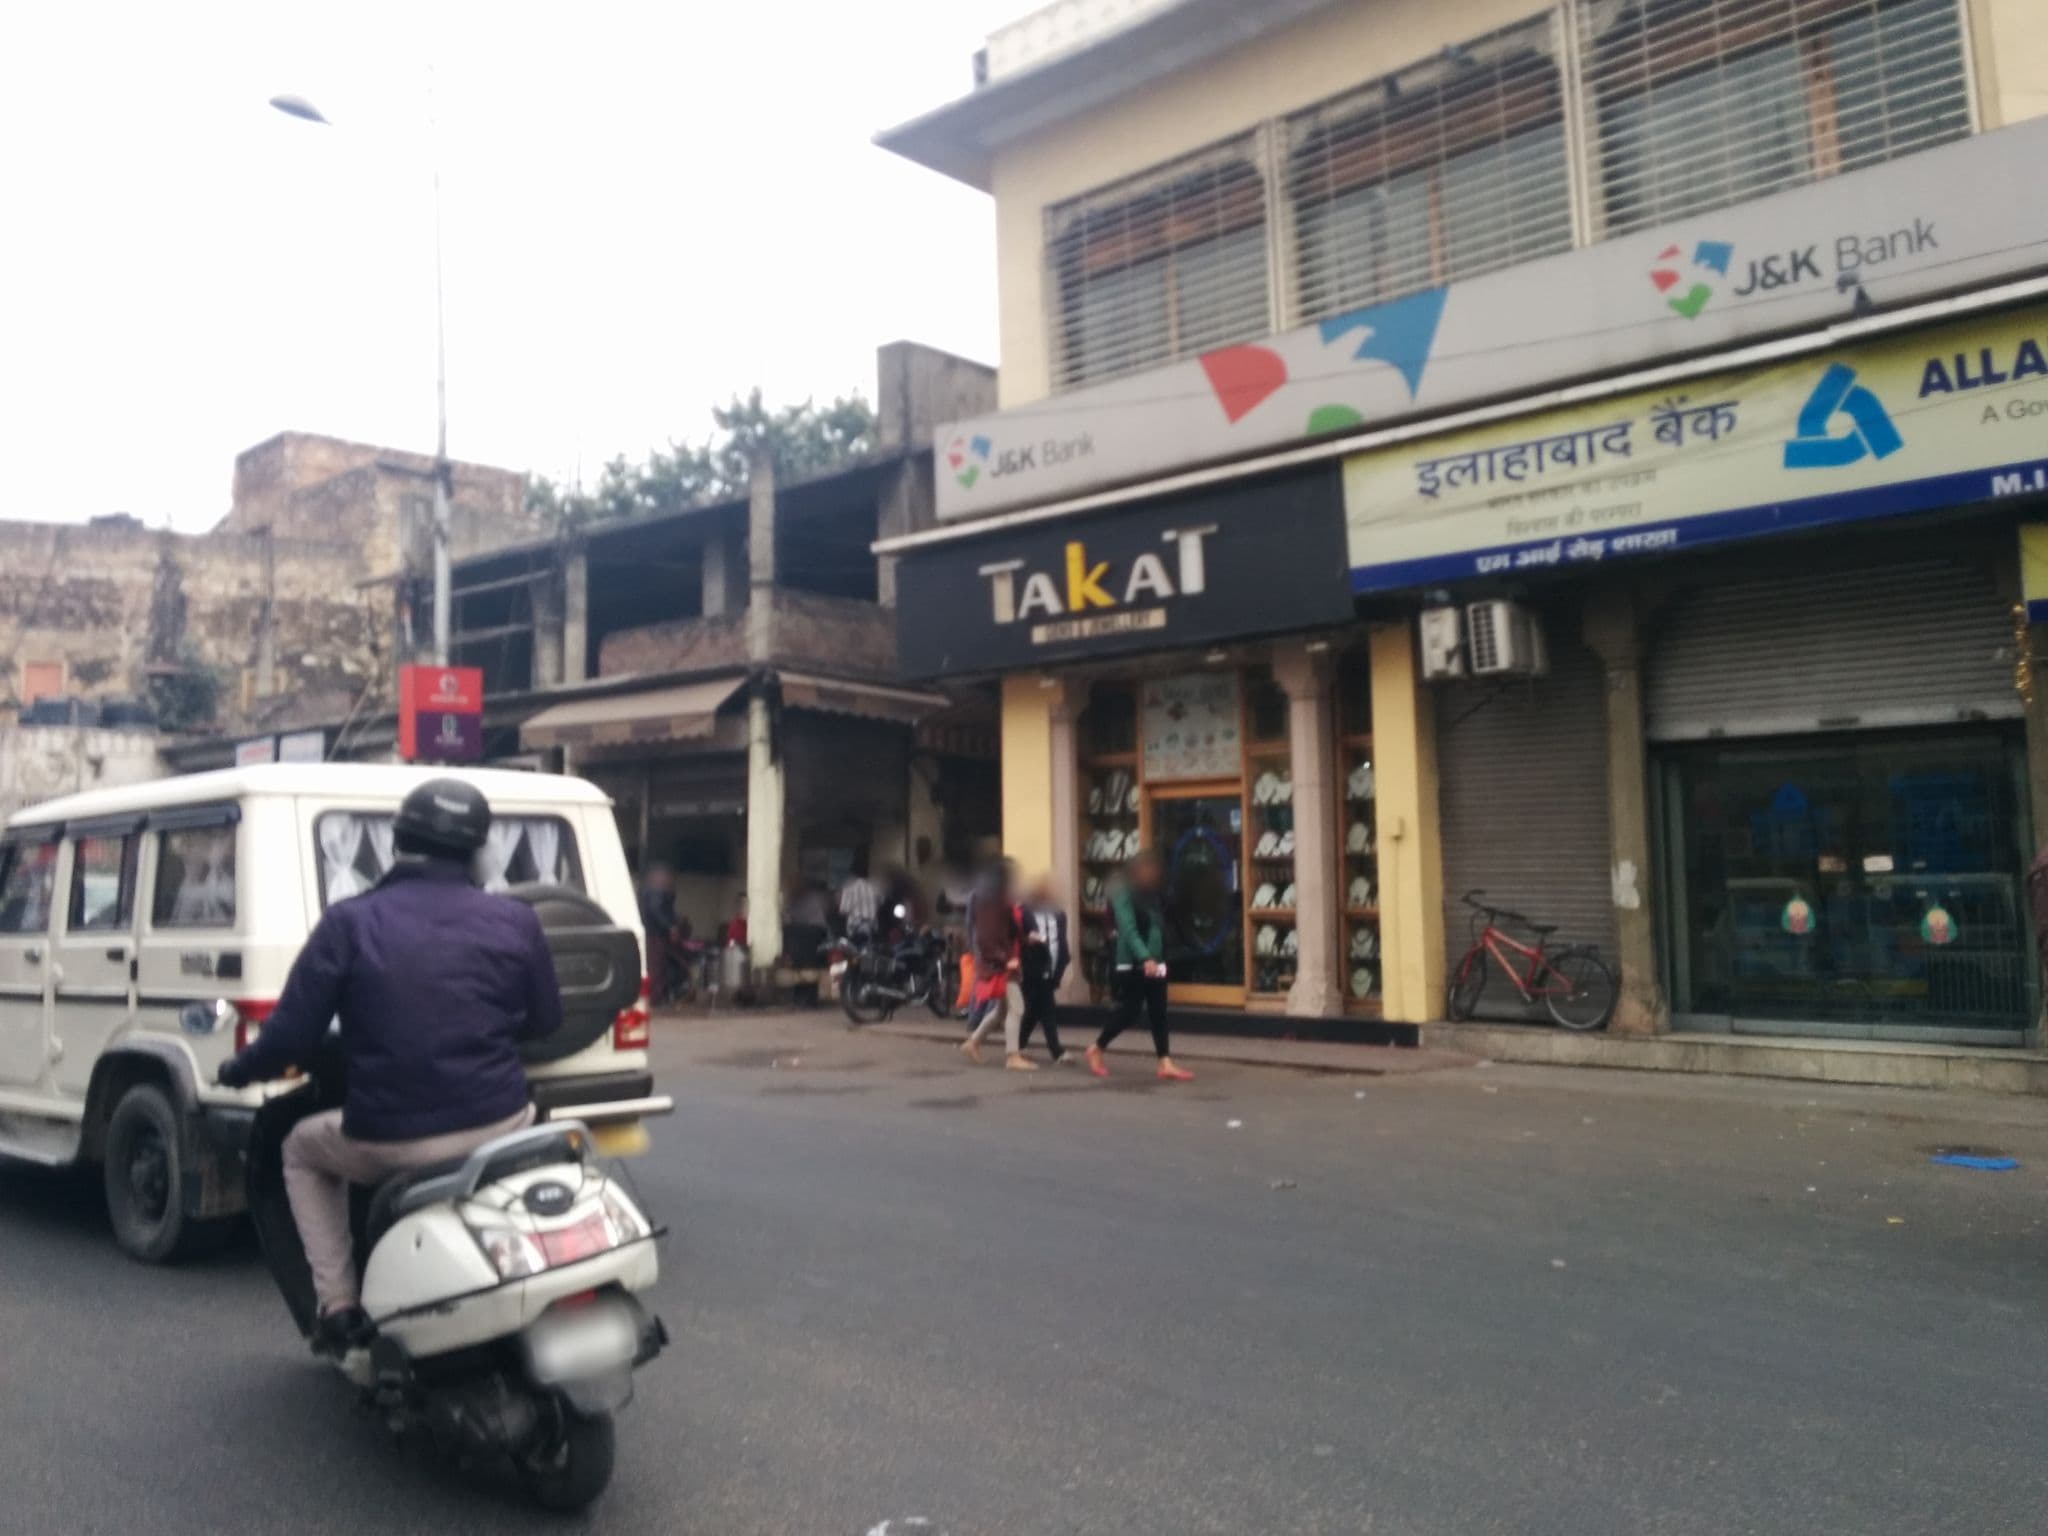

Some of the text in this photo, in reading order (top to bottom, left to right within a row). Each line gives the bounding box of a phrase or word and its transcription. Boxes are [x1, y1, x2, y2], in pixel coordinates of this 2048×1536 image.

[1735, 217, 1939, 297] J&K Bank
[1919, 338, 2048, 398] ALLA
[1981, 404, 2000, 425] A
[990, 431, 1096, 480] J&K Bank
[1415, 394, 1740, 499] इलाहाबाद बैंक
